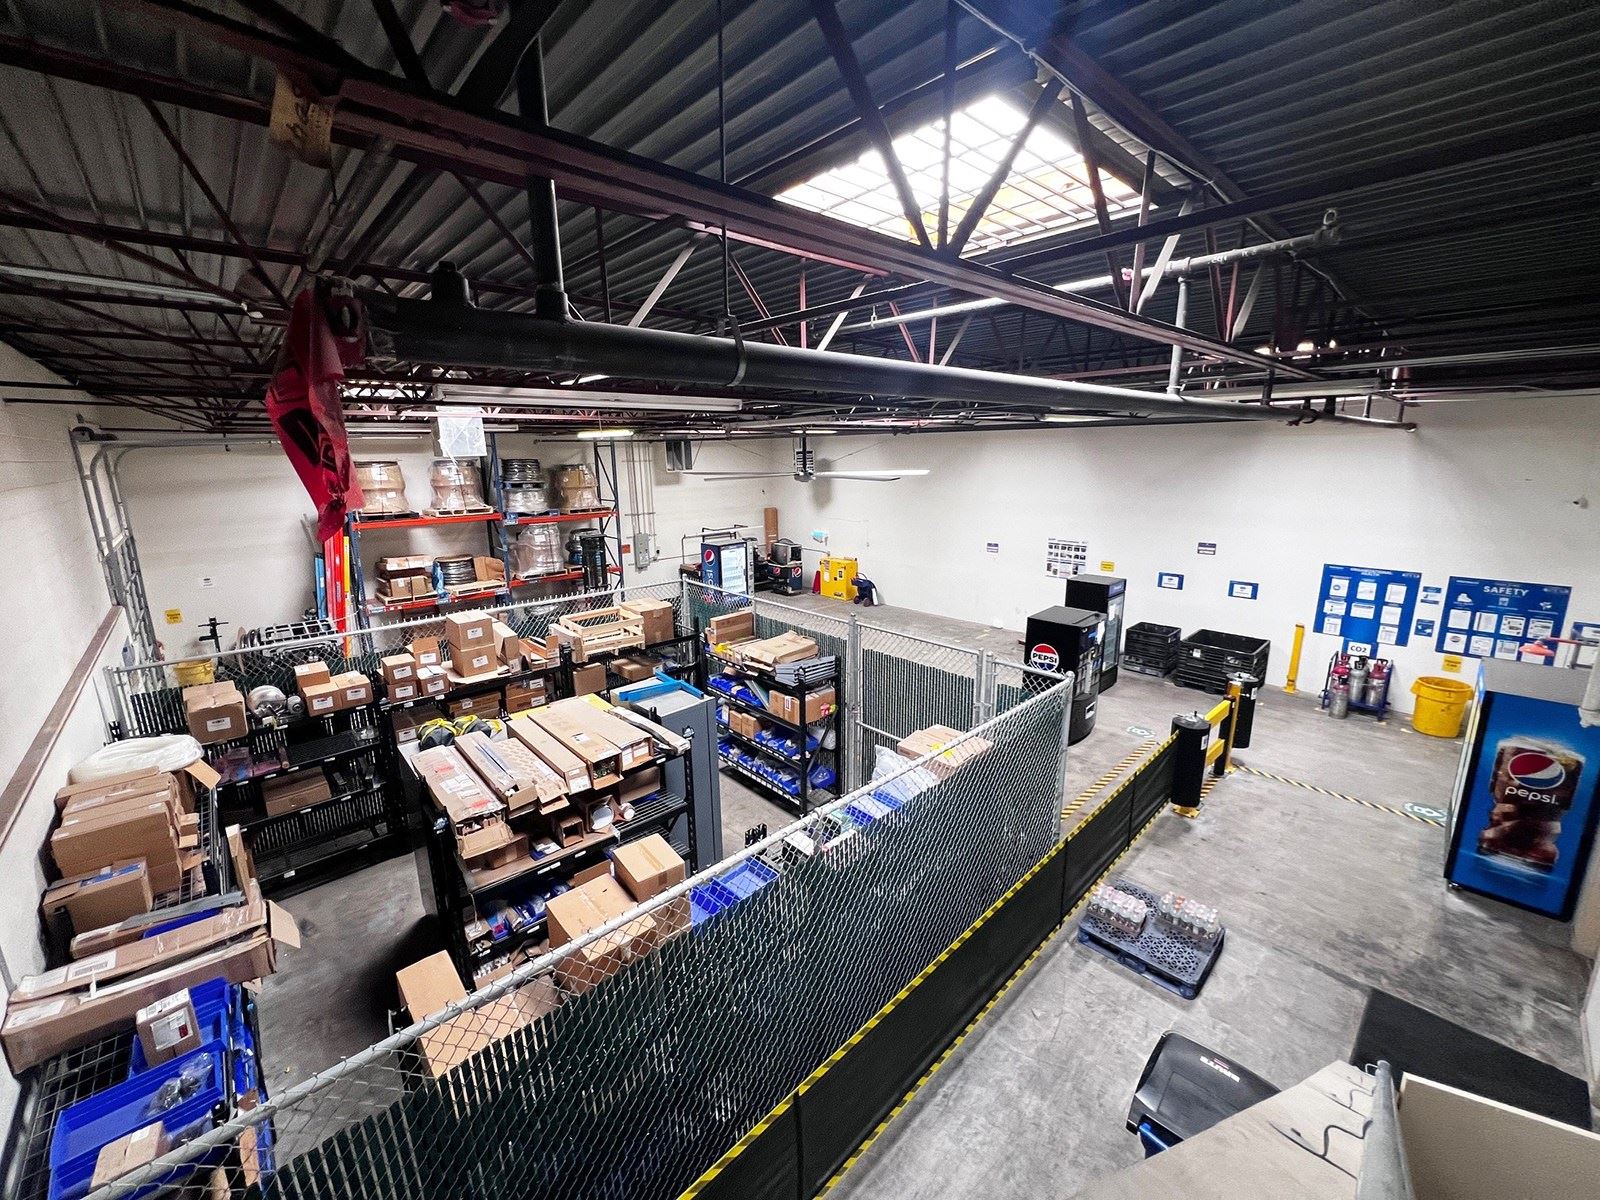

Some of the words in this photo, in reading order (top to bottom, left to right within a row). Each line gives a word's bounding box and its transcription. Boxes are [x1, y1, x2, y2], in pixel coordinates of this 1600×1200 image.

[1483, 585, 1529, 597] SAFETY
[1350, 645, 1367, 653] CO2
[1032, 652, 1057, 663] PEPSI
[1504, 786, 1557, 804] pepsi
